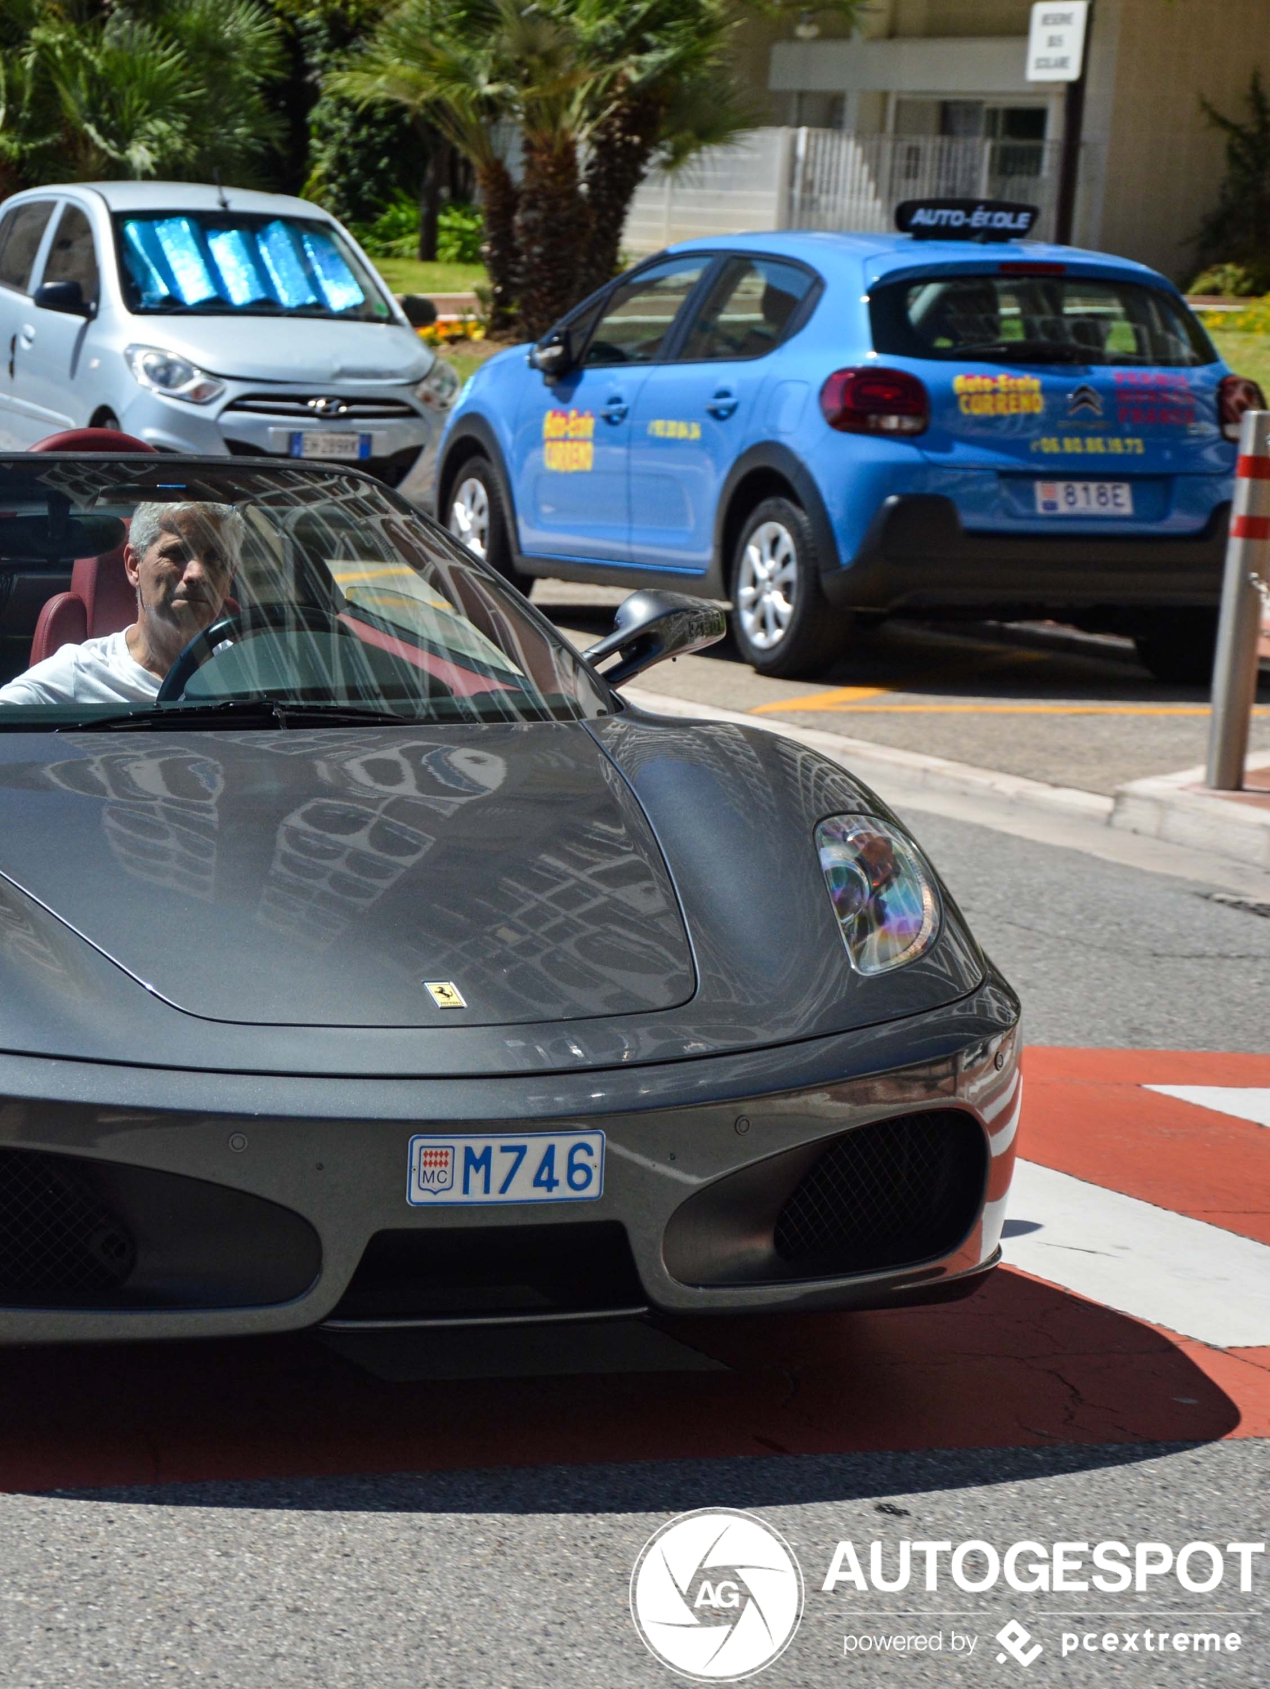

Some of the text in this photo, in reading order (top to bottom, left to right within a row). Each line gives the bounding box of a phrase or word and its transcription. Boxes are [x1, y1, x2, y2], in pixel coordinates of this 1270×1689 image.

[911, 205, 1031, 229] AUTO-ÉCOLE
[1064, 484, 1125, 507] 818E
[423, 1142, 594, 1195] MC M746
